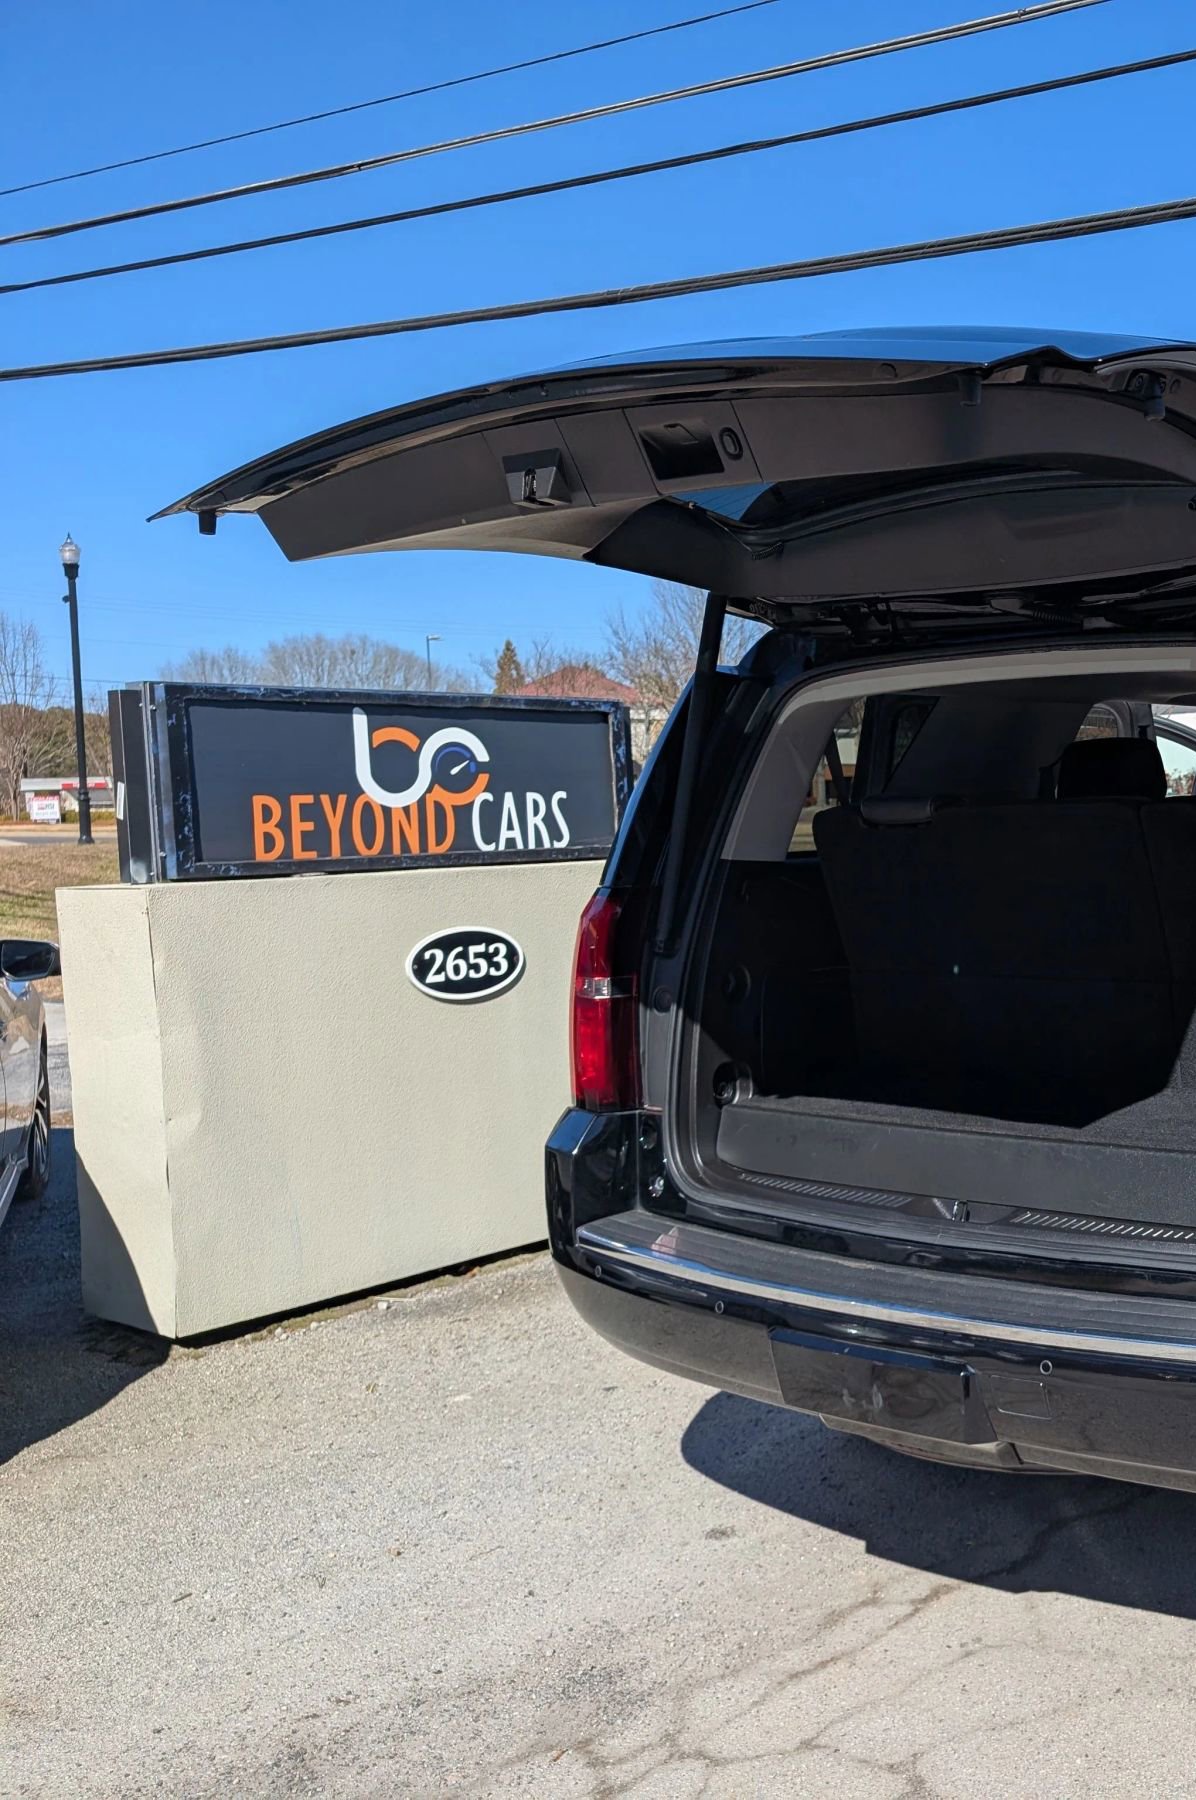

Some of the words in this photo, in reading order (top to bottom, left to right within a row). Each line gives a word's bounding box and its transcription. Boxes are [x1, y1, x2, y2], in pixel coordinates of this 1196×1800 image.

[252, 793, 456, 861] BEYOND
[472, 791, 570, 852] CARS
[424, 942, 509, 984] 2653
